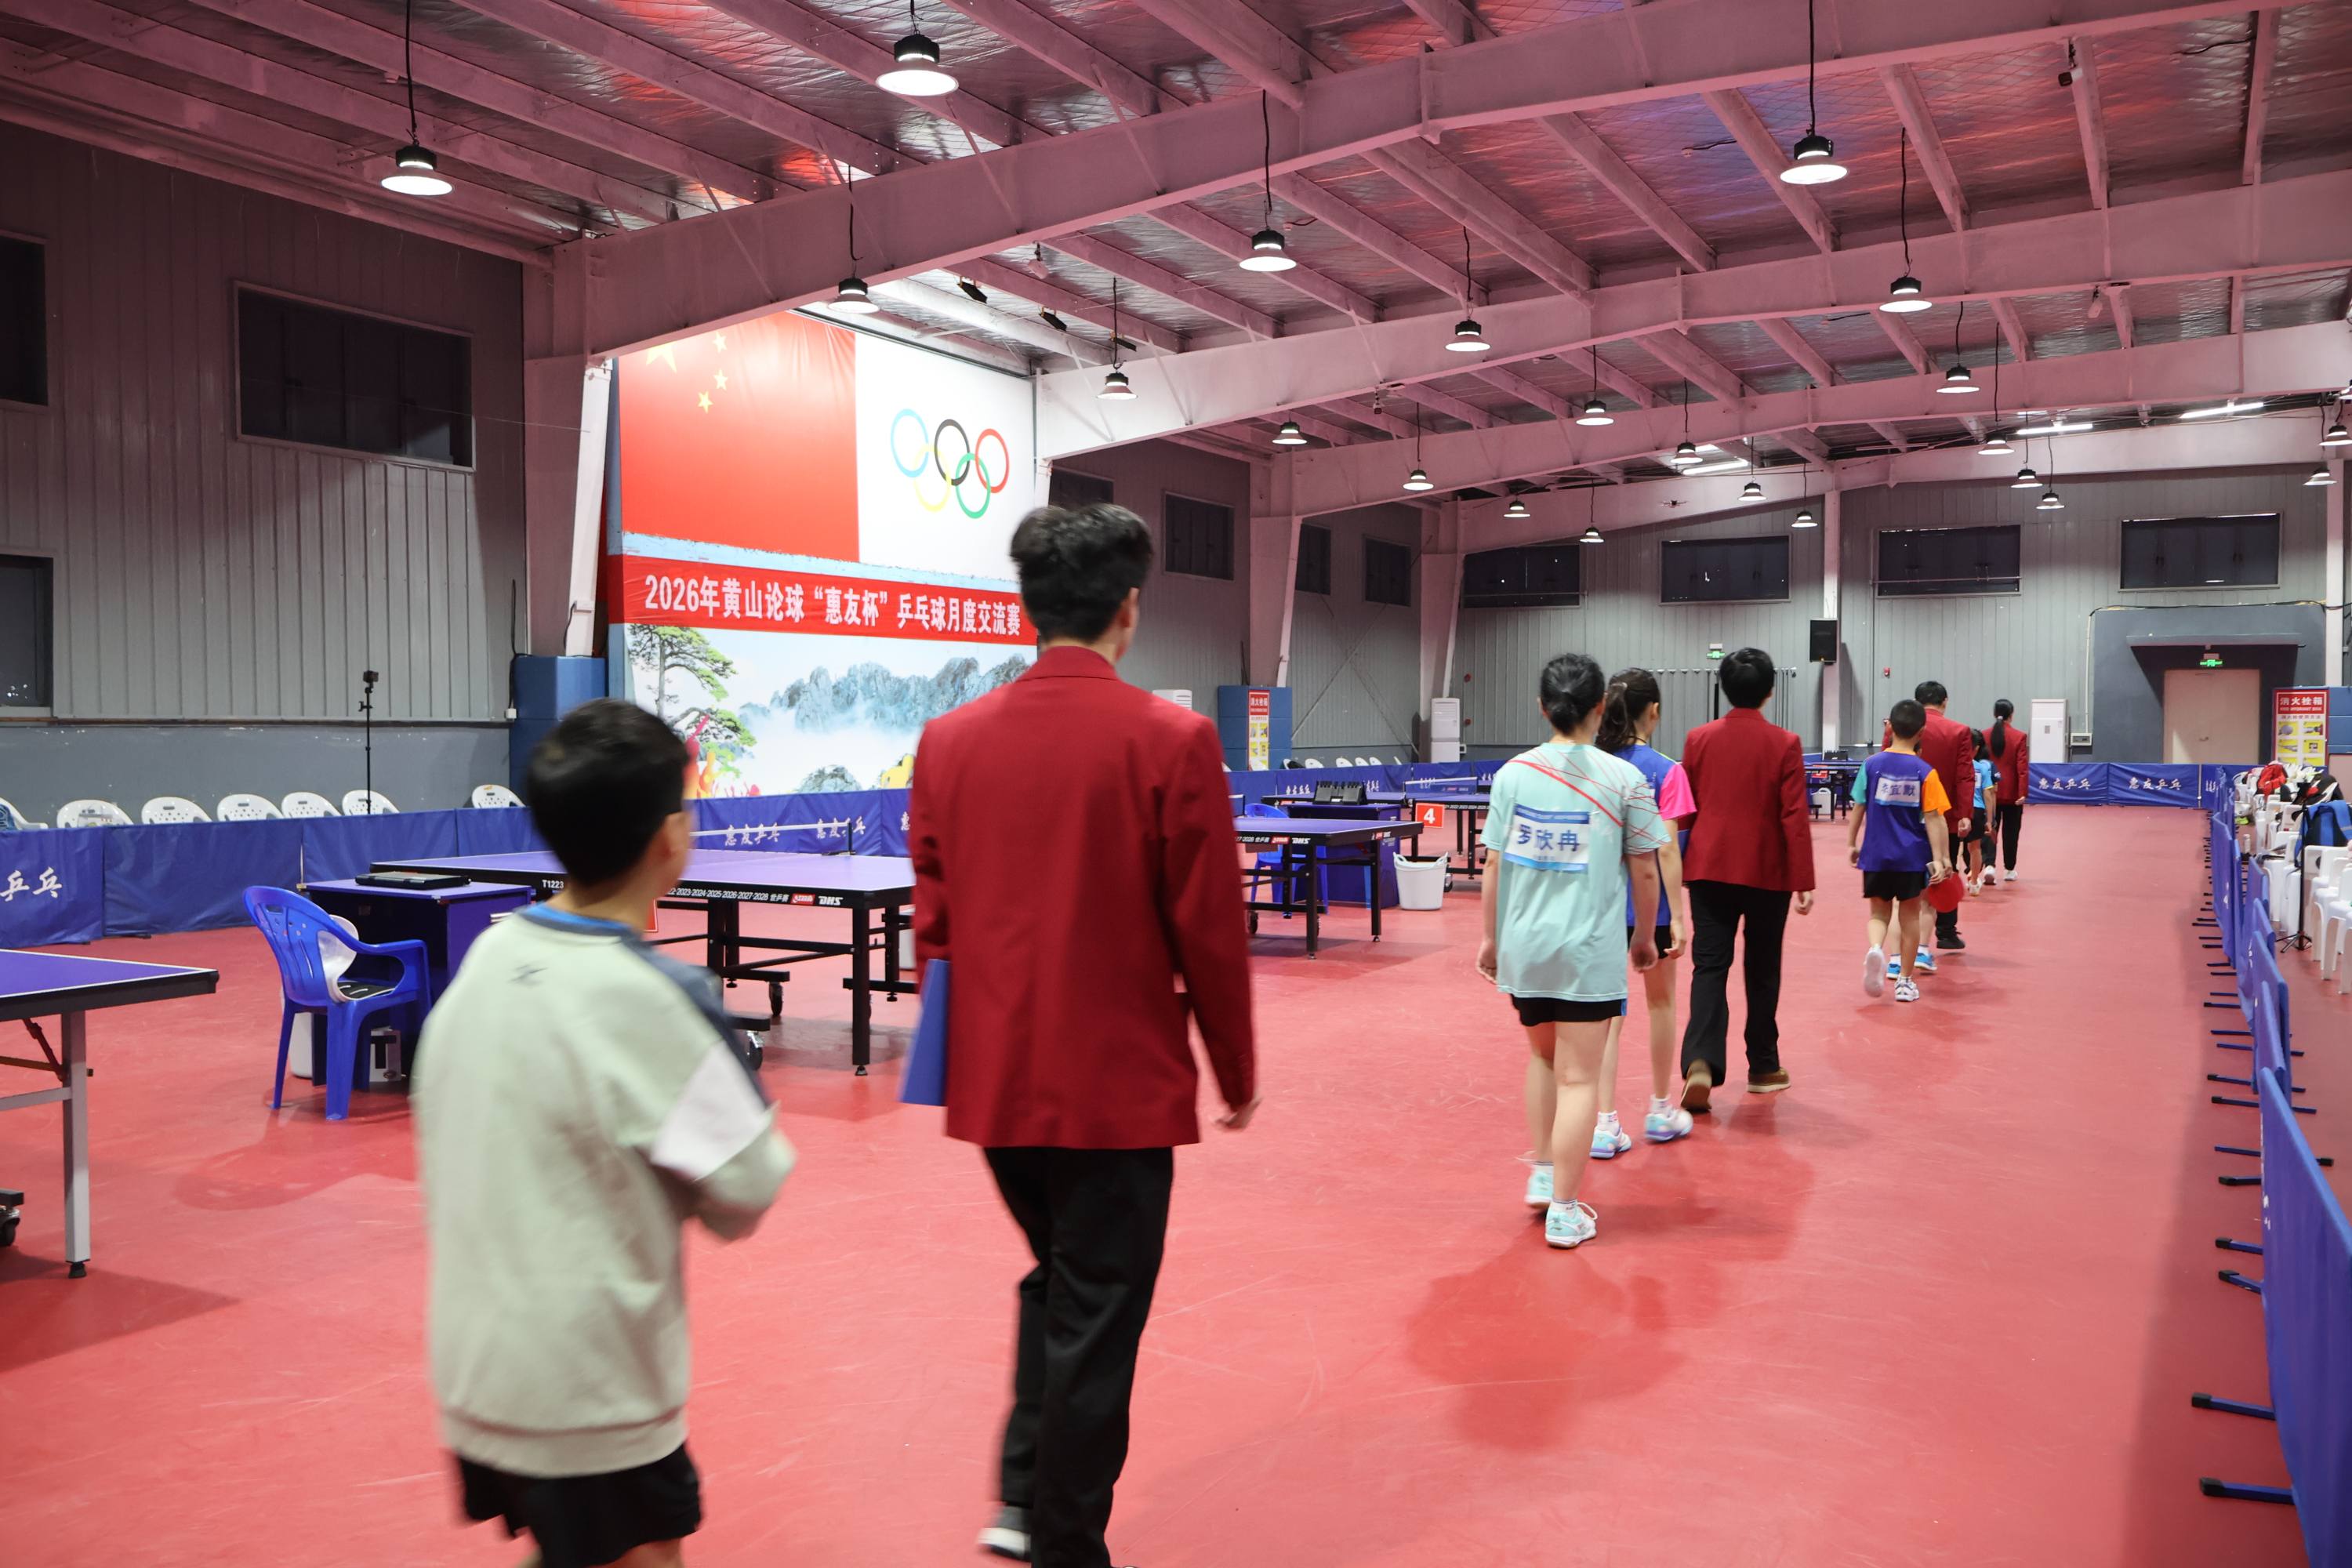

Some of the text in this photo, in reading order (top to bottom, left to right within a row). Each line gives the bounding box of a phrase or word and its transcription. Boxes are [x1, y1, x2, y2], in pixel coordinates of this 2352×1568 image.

[1423, 808, 1436, 824] 4
[542, 880, 564, 889] T1223
[818, 895, 844, 906] DHS
